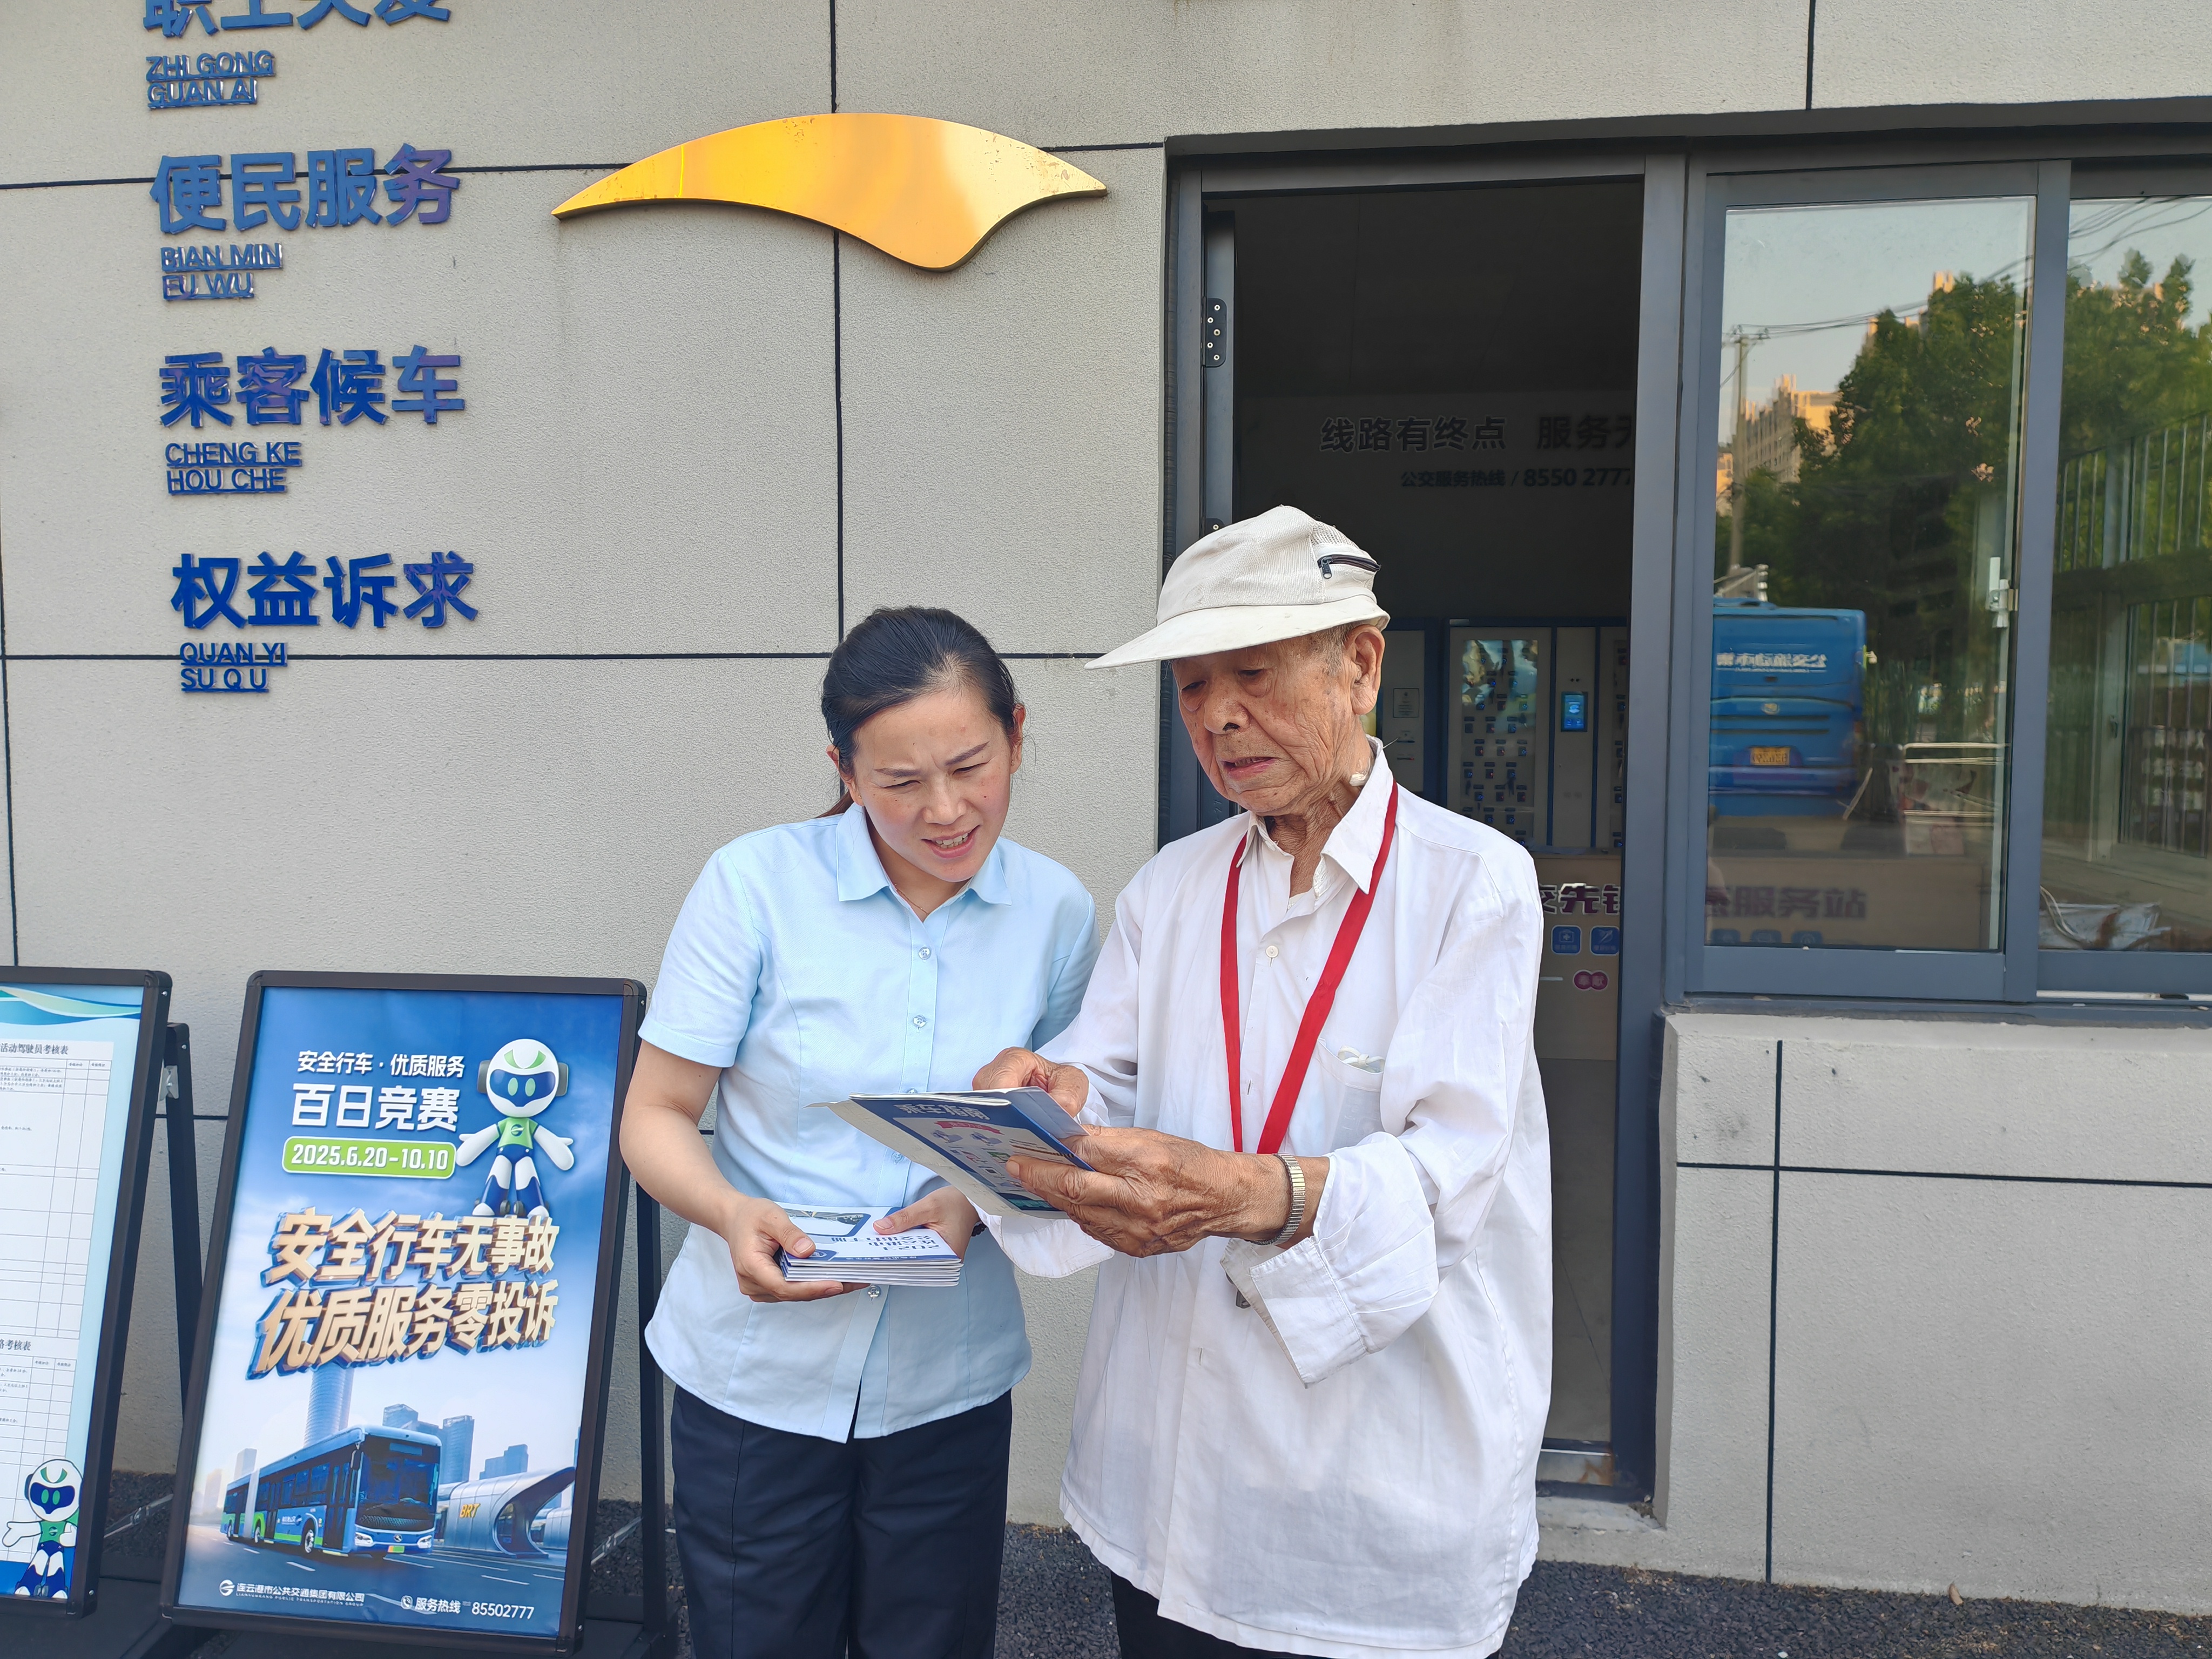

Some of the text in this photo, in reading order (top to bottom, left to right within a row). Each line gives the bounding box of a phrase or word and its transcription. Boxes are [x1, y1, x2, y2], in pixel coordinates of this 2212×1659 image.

[145, 50, 275, 82] ZHI GONG
[147, 78, 257, 107] GUAN AI
[149, 143, 461, 234] 便民服务
[160, 242, 284, 272] BIAN MIN
[205, 272, 254, 299] WU
[159, 345, 466, 428] 乘客候车
[1320, 416, 1507, 453] 线路有终点
[165, 442, 302, 466] CHENG KE
[166, 468, 287, 494] HOU CHE
[1400, 470, 1506, 488] 公交服务热线
[1523, 467, 1577, 488] 8550
[171, 550, 479, 629] 权益诉求
[179, 642, 287, 666] QUAN YI
[180, 668, 215, 692] SU
[0, 1042, 69, 1055] 活动驾驶员考核表
[291, 1082, 460, 1132] 百日竞赛
[893, 1103, 990, 1121] 乘车指南
[291, 1143, 449, 1171] 2025.6.20-10.10
[261, 1207, 560, 1287] 安全行车无事故
[246, 1278, 559, 1380] 优质服务零投诉
[459, 1503, 481, 1518] BRT
[237, 1583, 365, 1603] 连云港市公共交通集团有限公司
[414, 1597, 535, 1620] 服务热线 85502777
